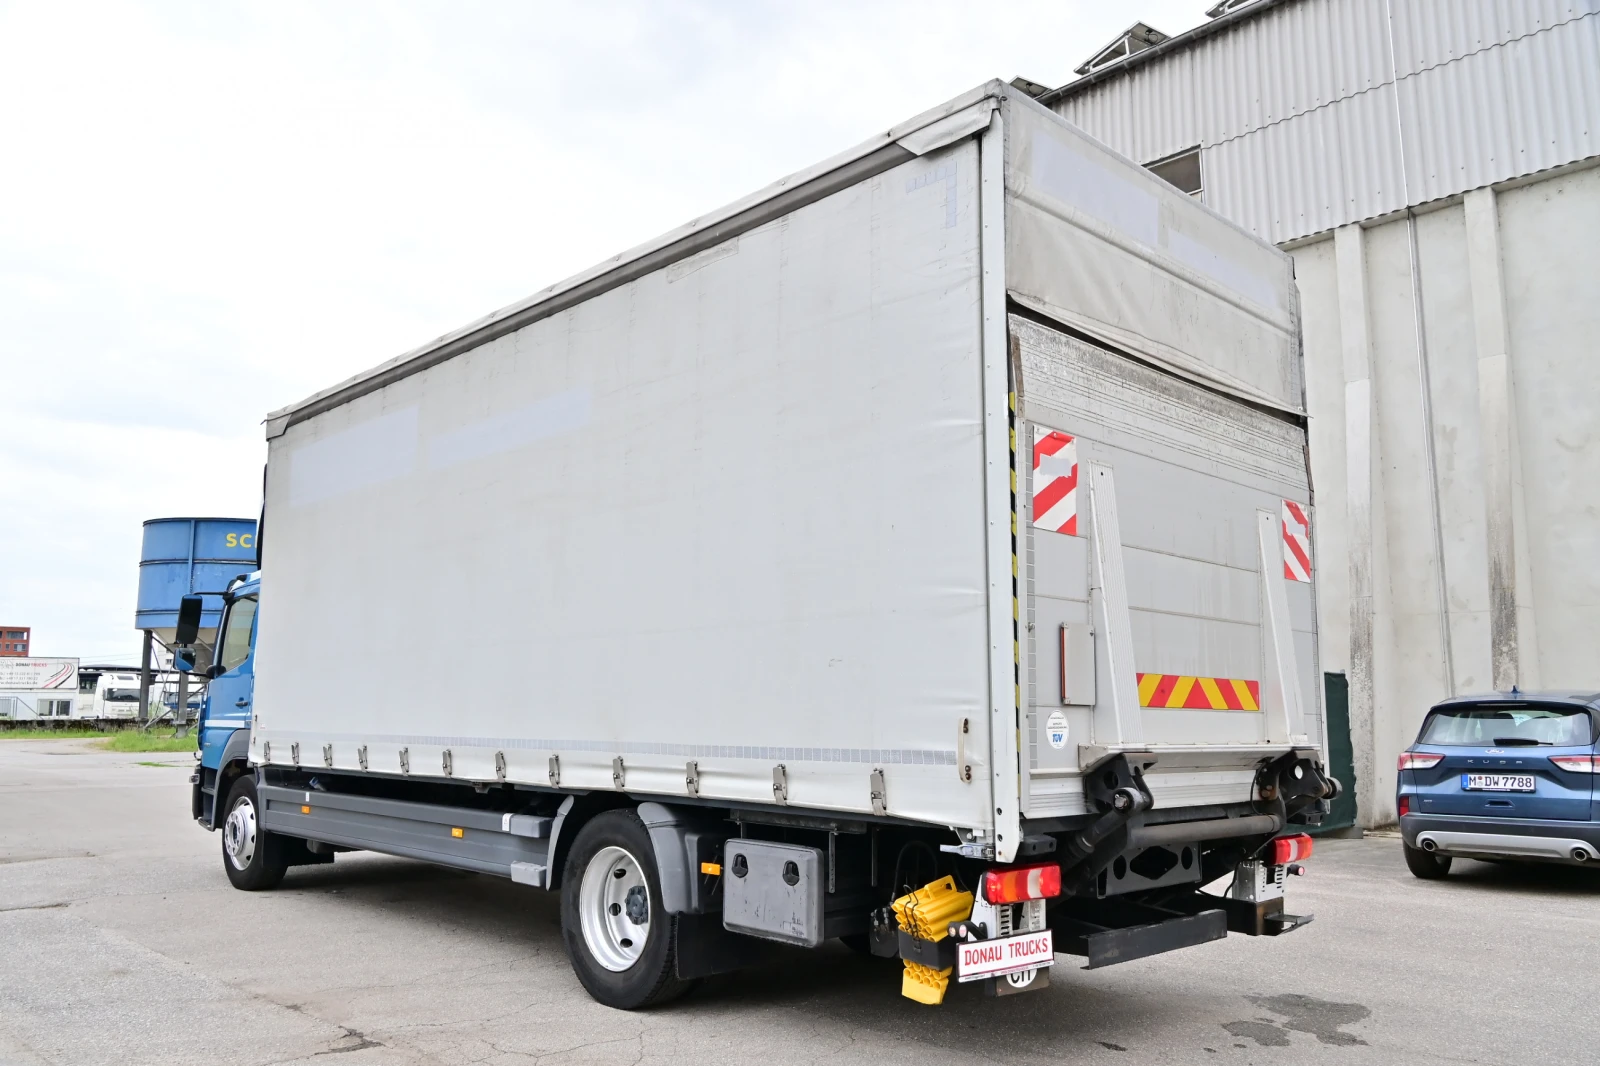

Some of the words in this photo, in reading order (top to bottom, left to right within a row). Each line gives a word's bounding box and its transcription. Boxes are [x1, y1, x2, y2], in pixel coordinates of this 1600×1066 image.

[226, 533, 257, 548] SC
[1468, 776, 1477, 786] M
[1484, 776, 1500, 787] DW
[1502, 777, 1532, 788] 7788
[964, 945, 1003, 967] DONAU
[1008, 937, 1049, 959] TRUCKS
